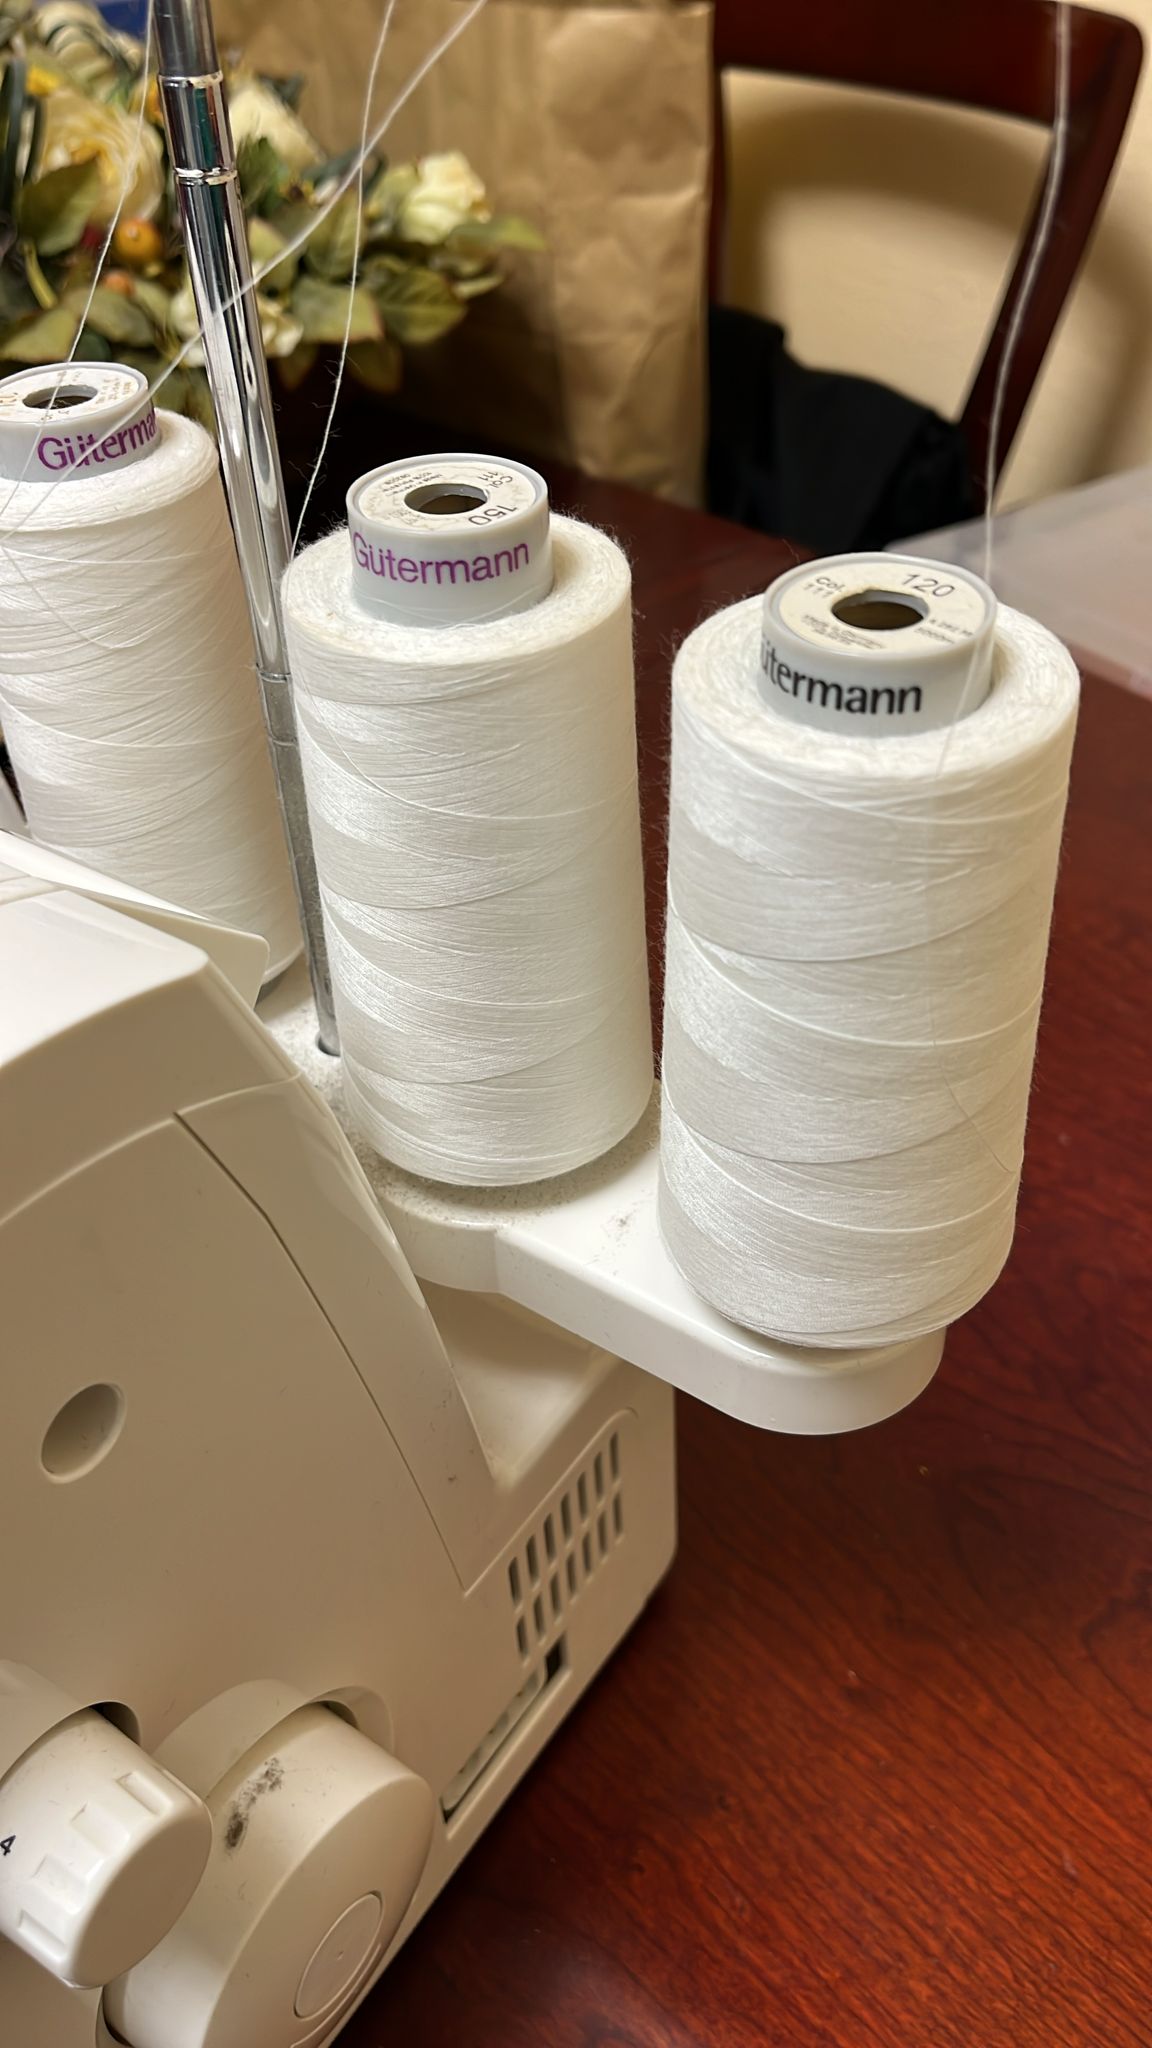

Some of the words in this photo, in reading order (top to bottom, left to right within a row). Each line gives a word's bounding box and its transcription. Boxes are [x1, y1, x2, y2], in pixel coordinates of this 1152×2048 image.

[37, 410, 156, 470] Güterma
[468, 504, 517, 525] 150
[352, 531, 529, 585] Gütermann
[902, 573, 956, 597] 120
[760, 634, 922, 715] ütermann
[0, 1834, 16, 1856] 4
